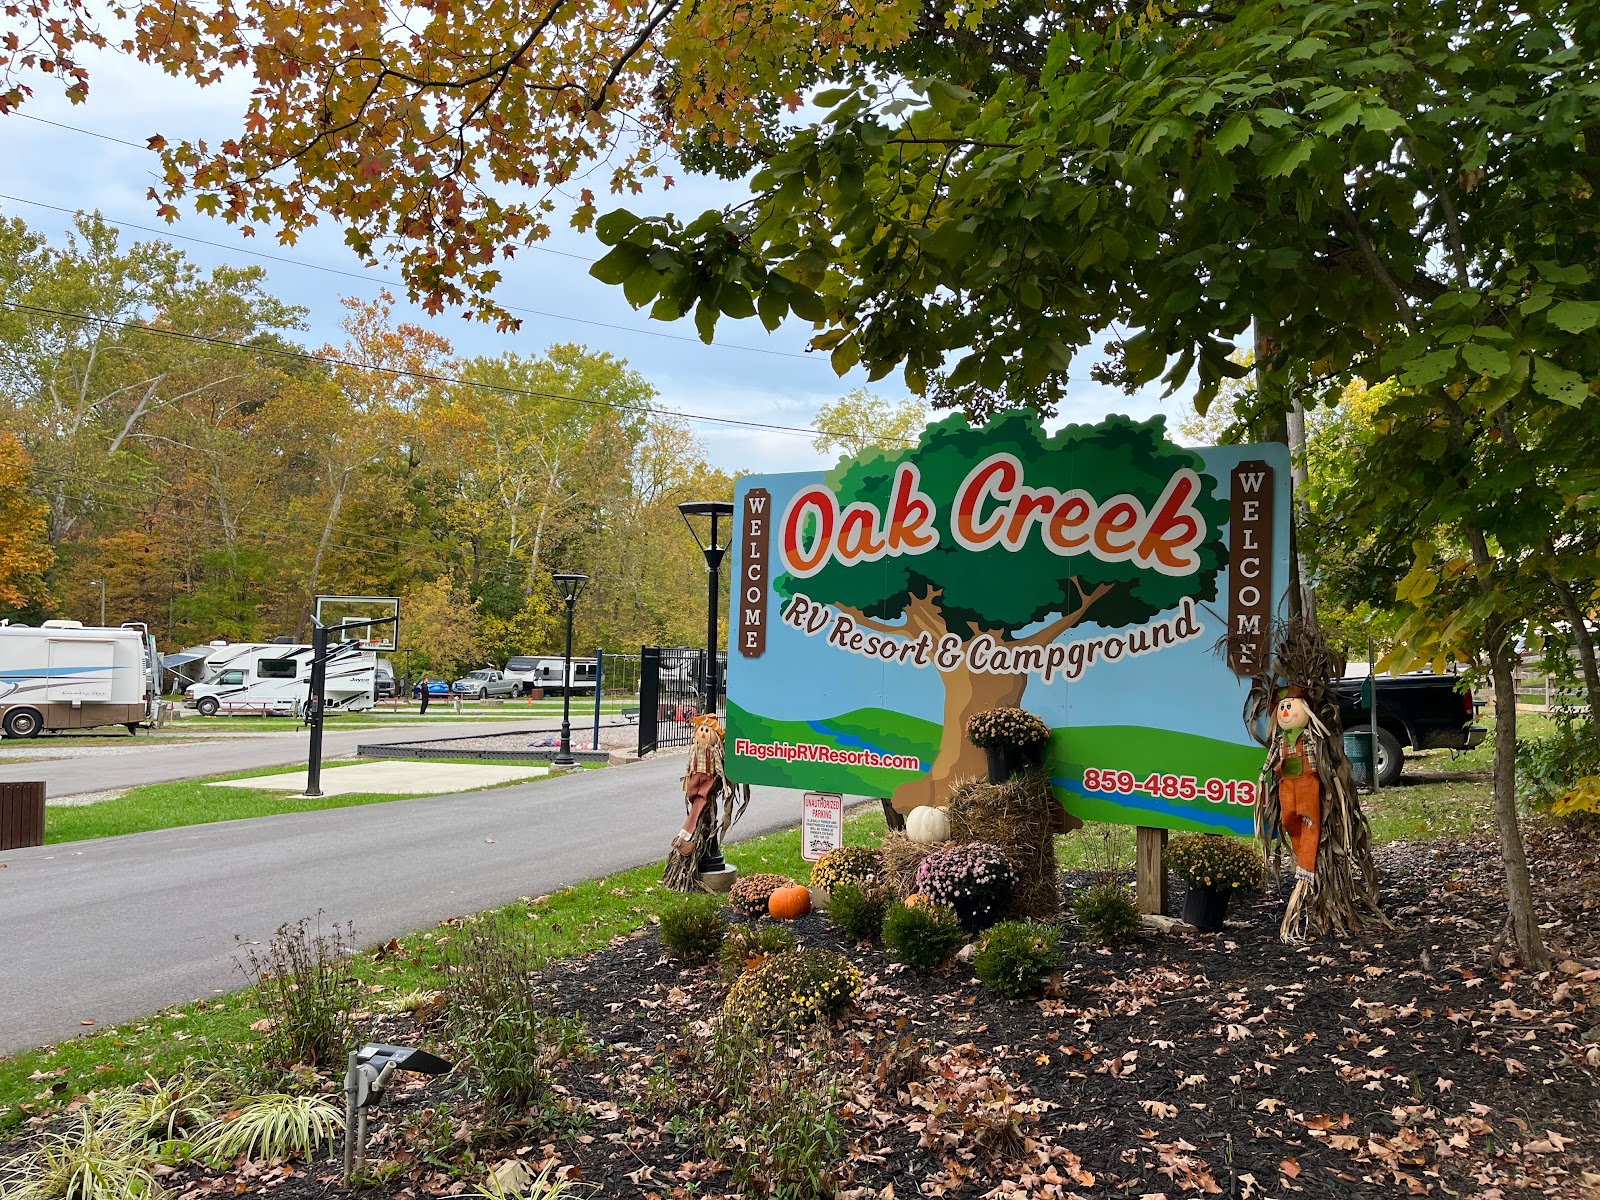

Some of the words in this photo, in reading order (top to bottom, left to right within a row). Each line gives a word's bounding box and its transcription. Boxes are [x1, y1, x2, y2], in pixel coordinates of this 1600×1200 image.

[783, 467, 935, 573] Oak
[956, 458, 1202, 569] Creek
[745, 497, 766, 649] WELCOME
[1237, 472, 1265, 664] WELCOME
[785, 597, 829, 635] RV
[834, 616, 930, 666] Resort
[938, 642, 962, 668] &
[967, 601, 1199, 682] Campground
[735, 740, 919, 771] FlagshipRVResorts.com
[806, 799, 839, 810] UNAUTHORIZED
[812, 809, 832, 819] PARKING
